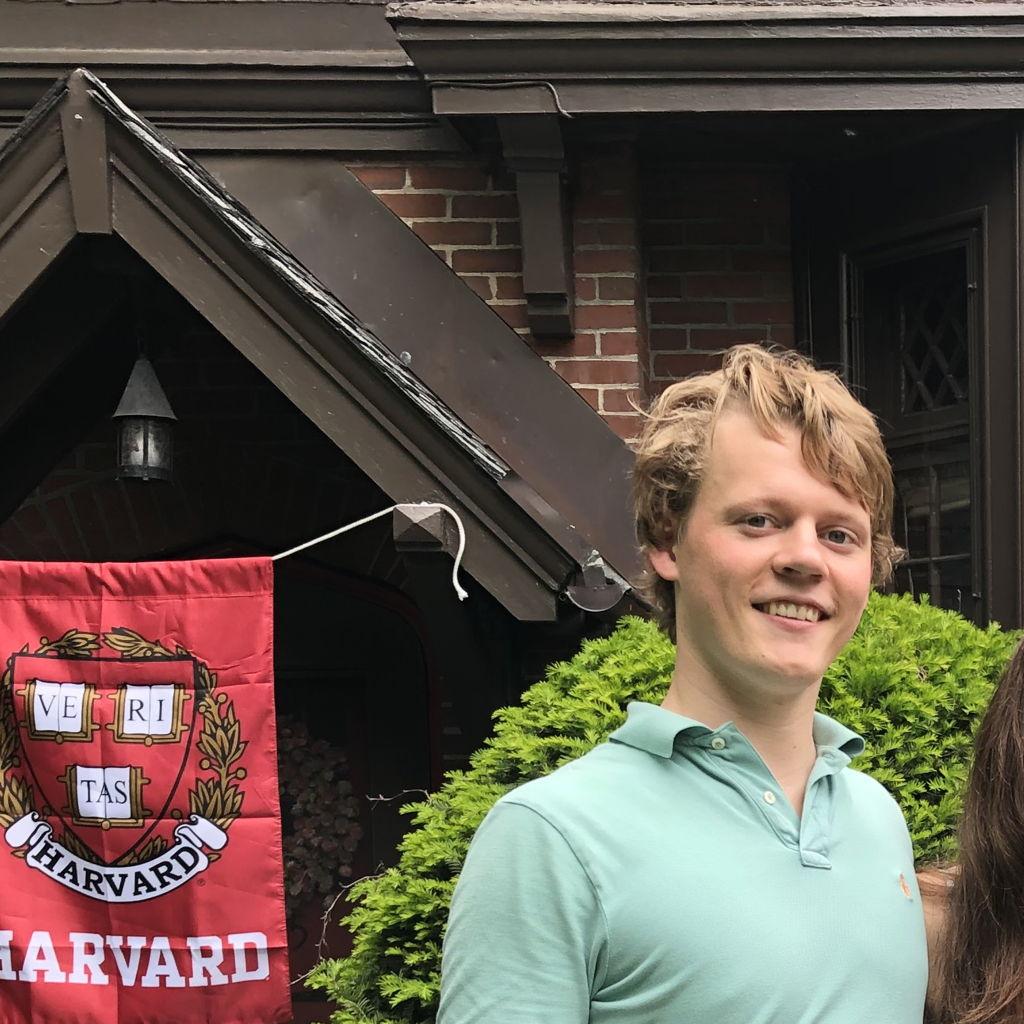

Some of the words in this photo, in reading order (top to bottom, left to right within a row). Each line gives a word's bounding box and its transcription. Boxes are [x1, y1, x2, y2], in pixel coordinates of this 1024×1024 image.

[37, 694, 78, 719] VE
[127, 699, 165, 722] RI
[80, 779, 128, 804] TAS
[31, 839, 200, 897] HARVARD
